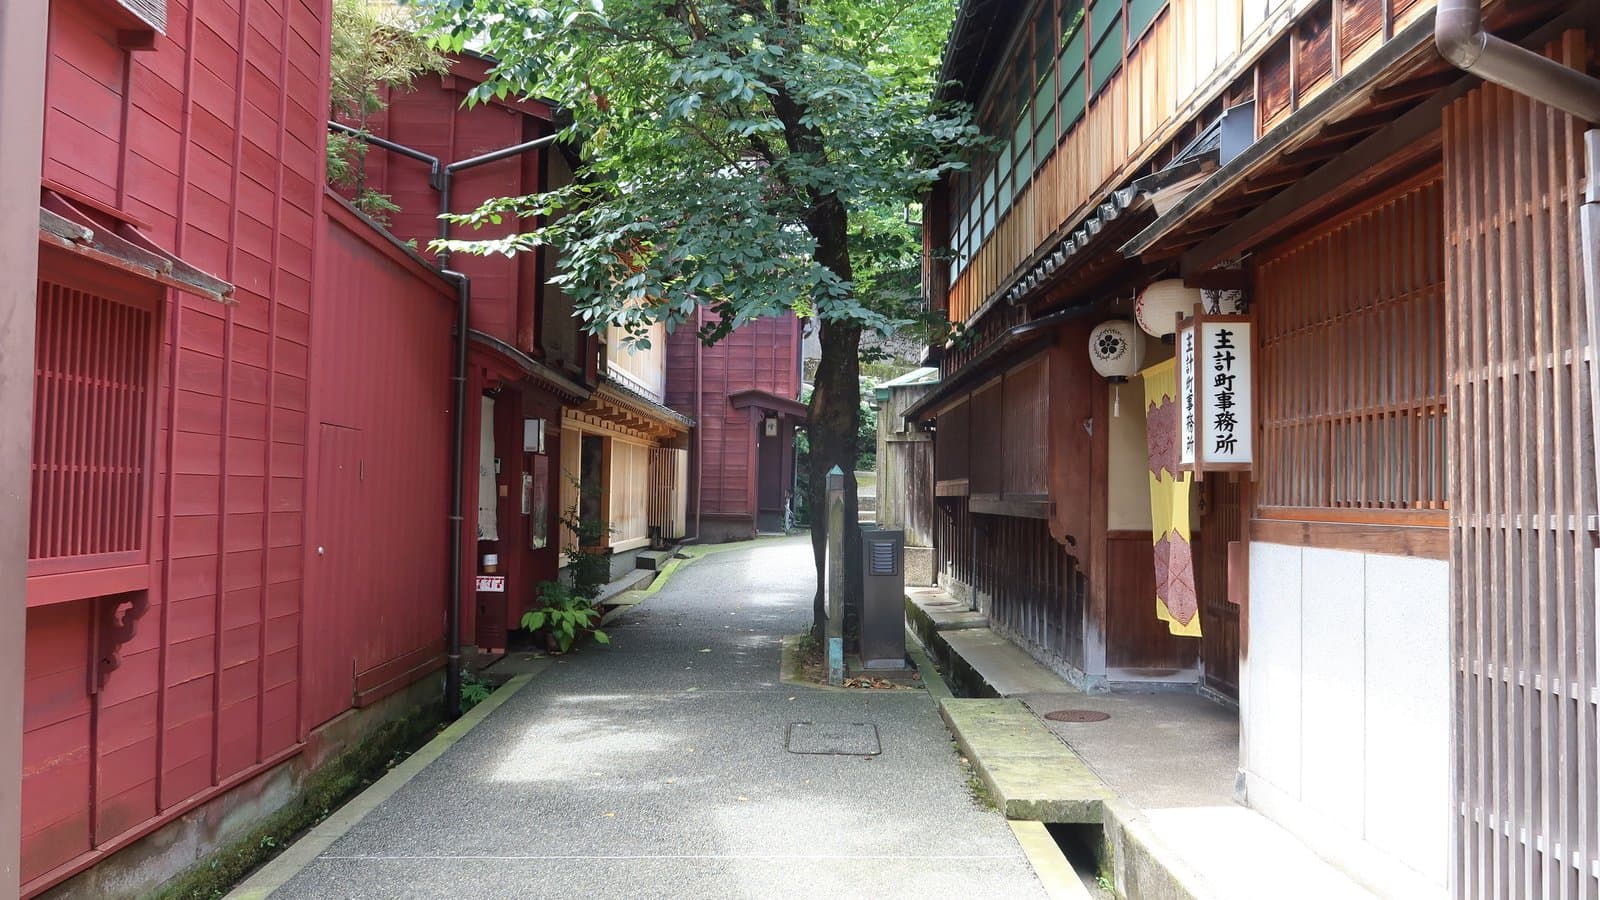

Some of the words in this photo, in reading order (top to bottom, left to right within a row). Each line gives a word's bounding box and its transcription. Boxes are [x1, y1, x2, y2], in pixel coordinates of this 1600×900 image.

[1213, 328, 1239, 455] 主計町事務所
